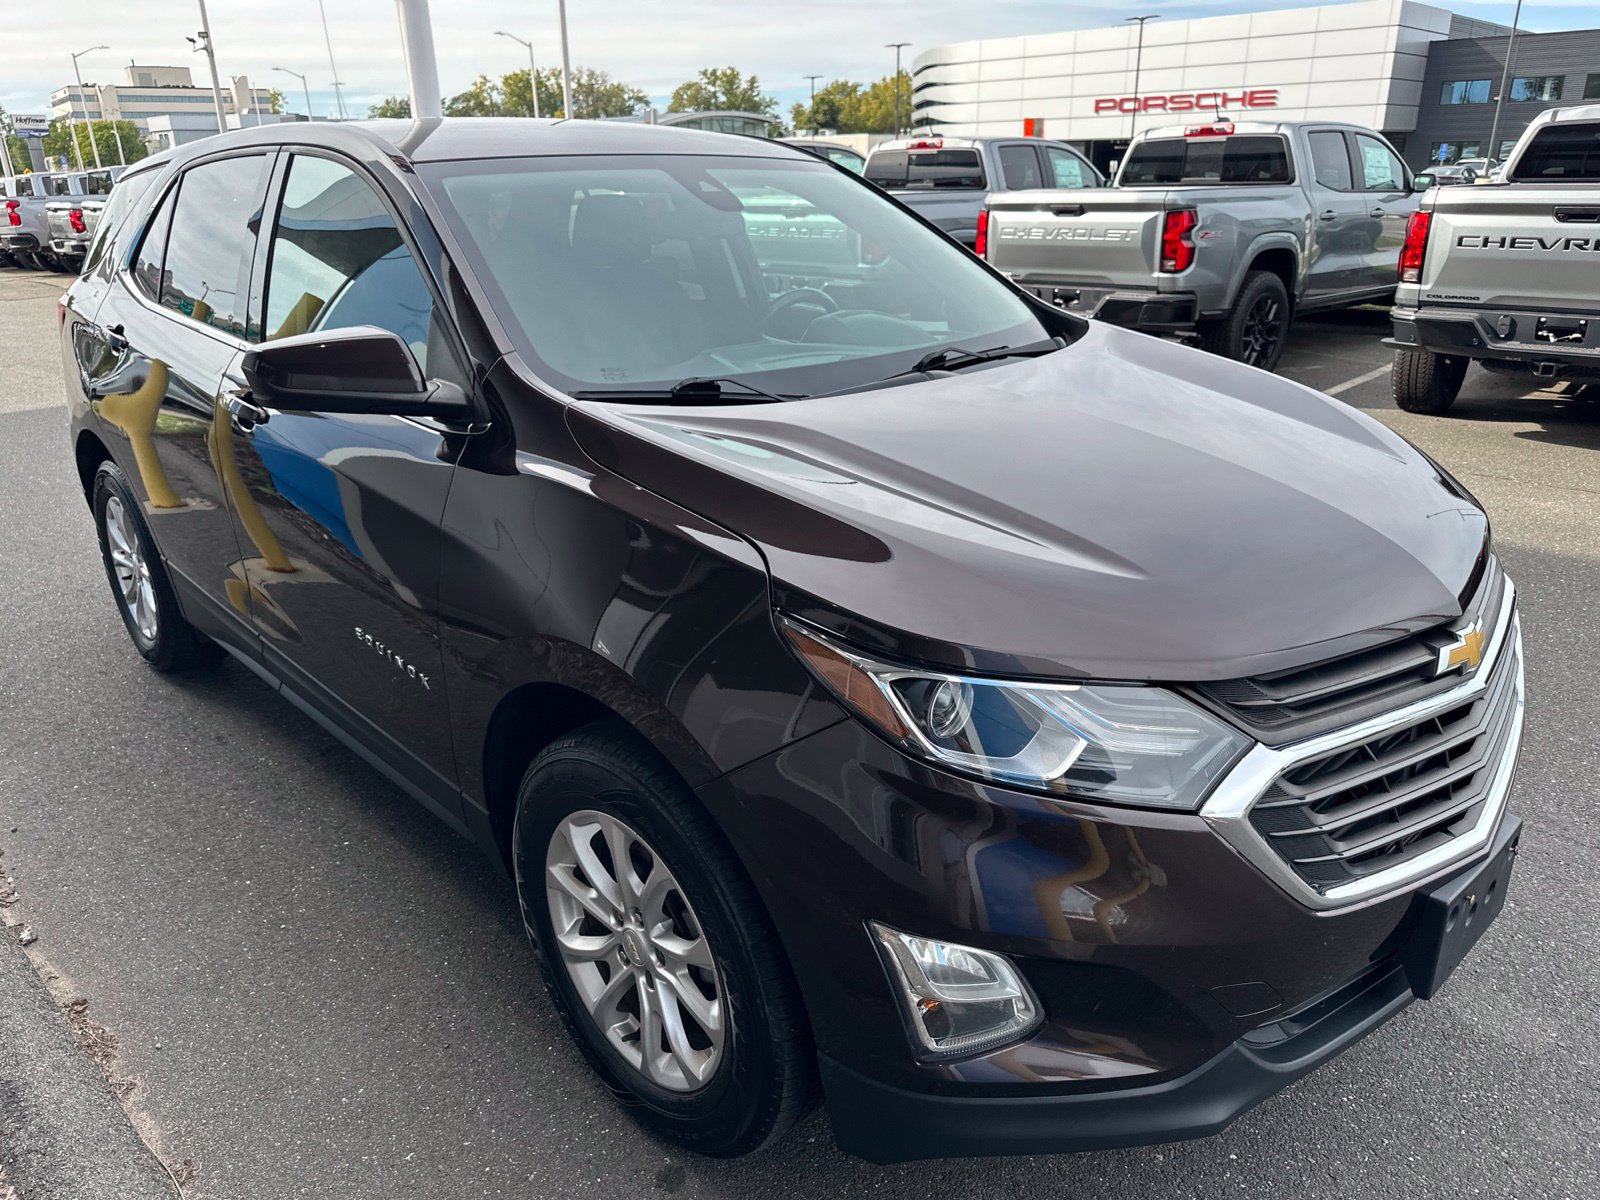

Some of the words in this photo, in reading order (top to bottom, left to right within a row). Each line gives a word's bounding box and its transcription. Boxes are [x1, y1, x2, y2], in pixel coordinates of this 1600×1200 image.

[1094, 89, 1278, 113] PORSCHE
[15, 116, 46, 125] Hoffman
[1000, 227, 1139, 241] CHEVROLET
[1456, 235, 1600, 252] CHEVR
[1426, 293, 1480, 301] COLORADO
[355, 627, 431, 690] EQUINOX
